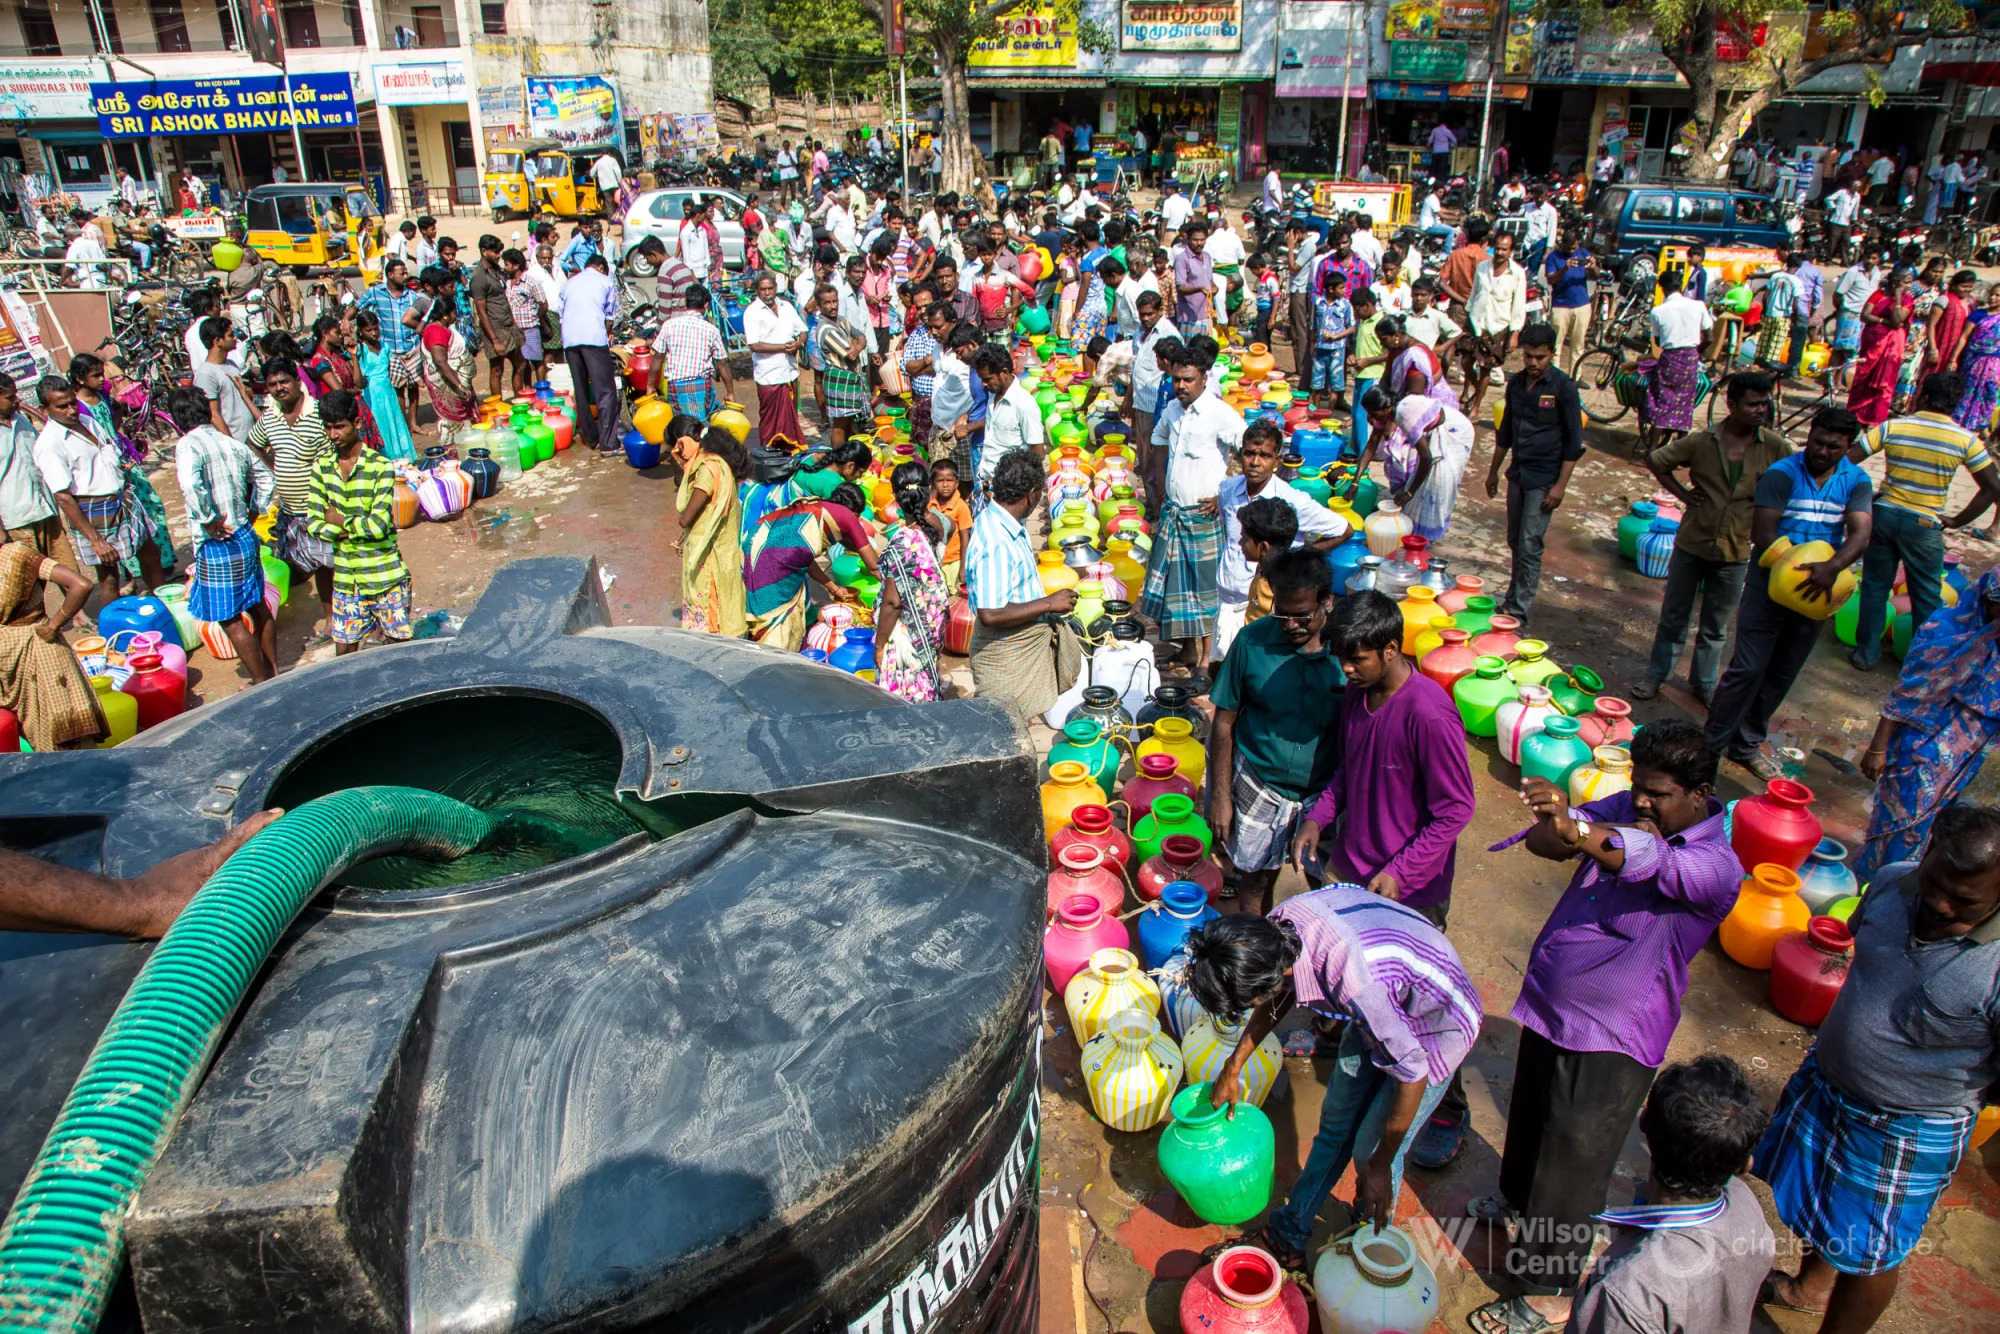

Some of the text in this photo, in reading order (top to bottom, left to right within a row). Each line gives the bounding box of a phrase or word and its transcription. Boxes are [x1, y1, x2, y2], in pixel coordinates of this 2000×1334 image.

[9, 82, 67, 93] SURGICALS
[137, 87, 230, 110] அசோக்
[237, 83, 316, 106] பவான்
[111, 108, 342, 133] SRI ASHOK BHAVAAN VEG
